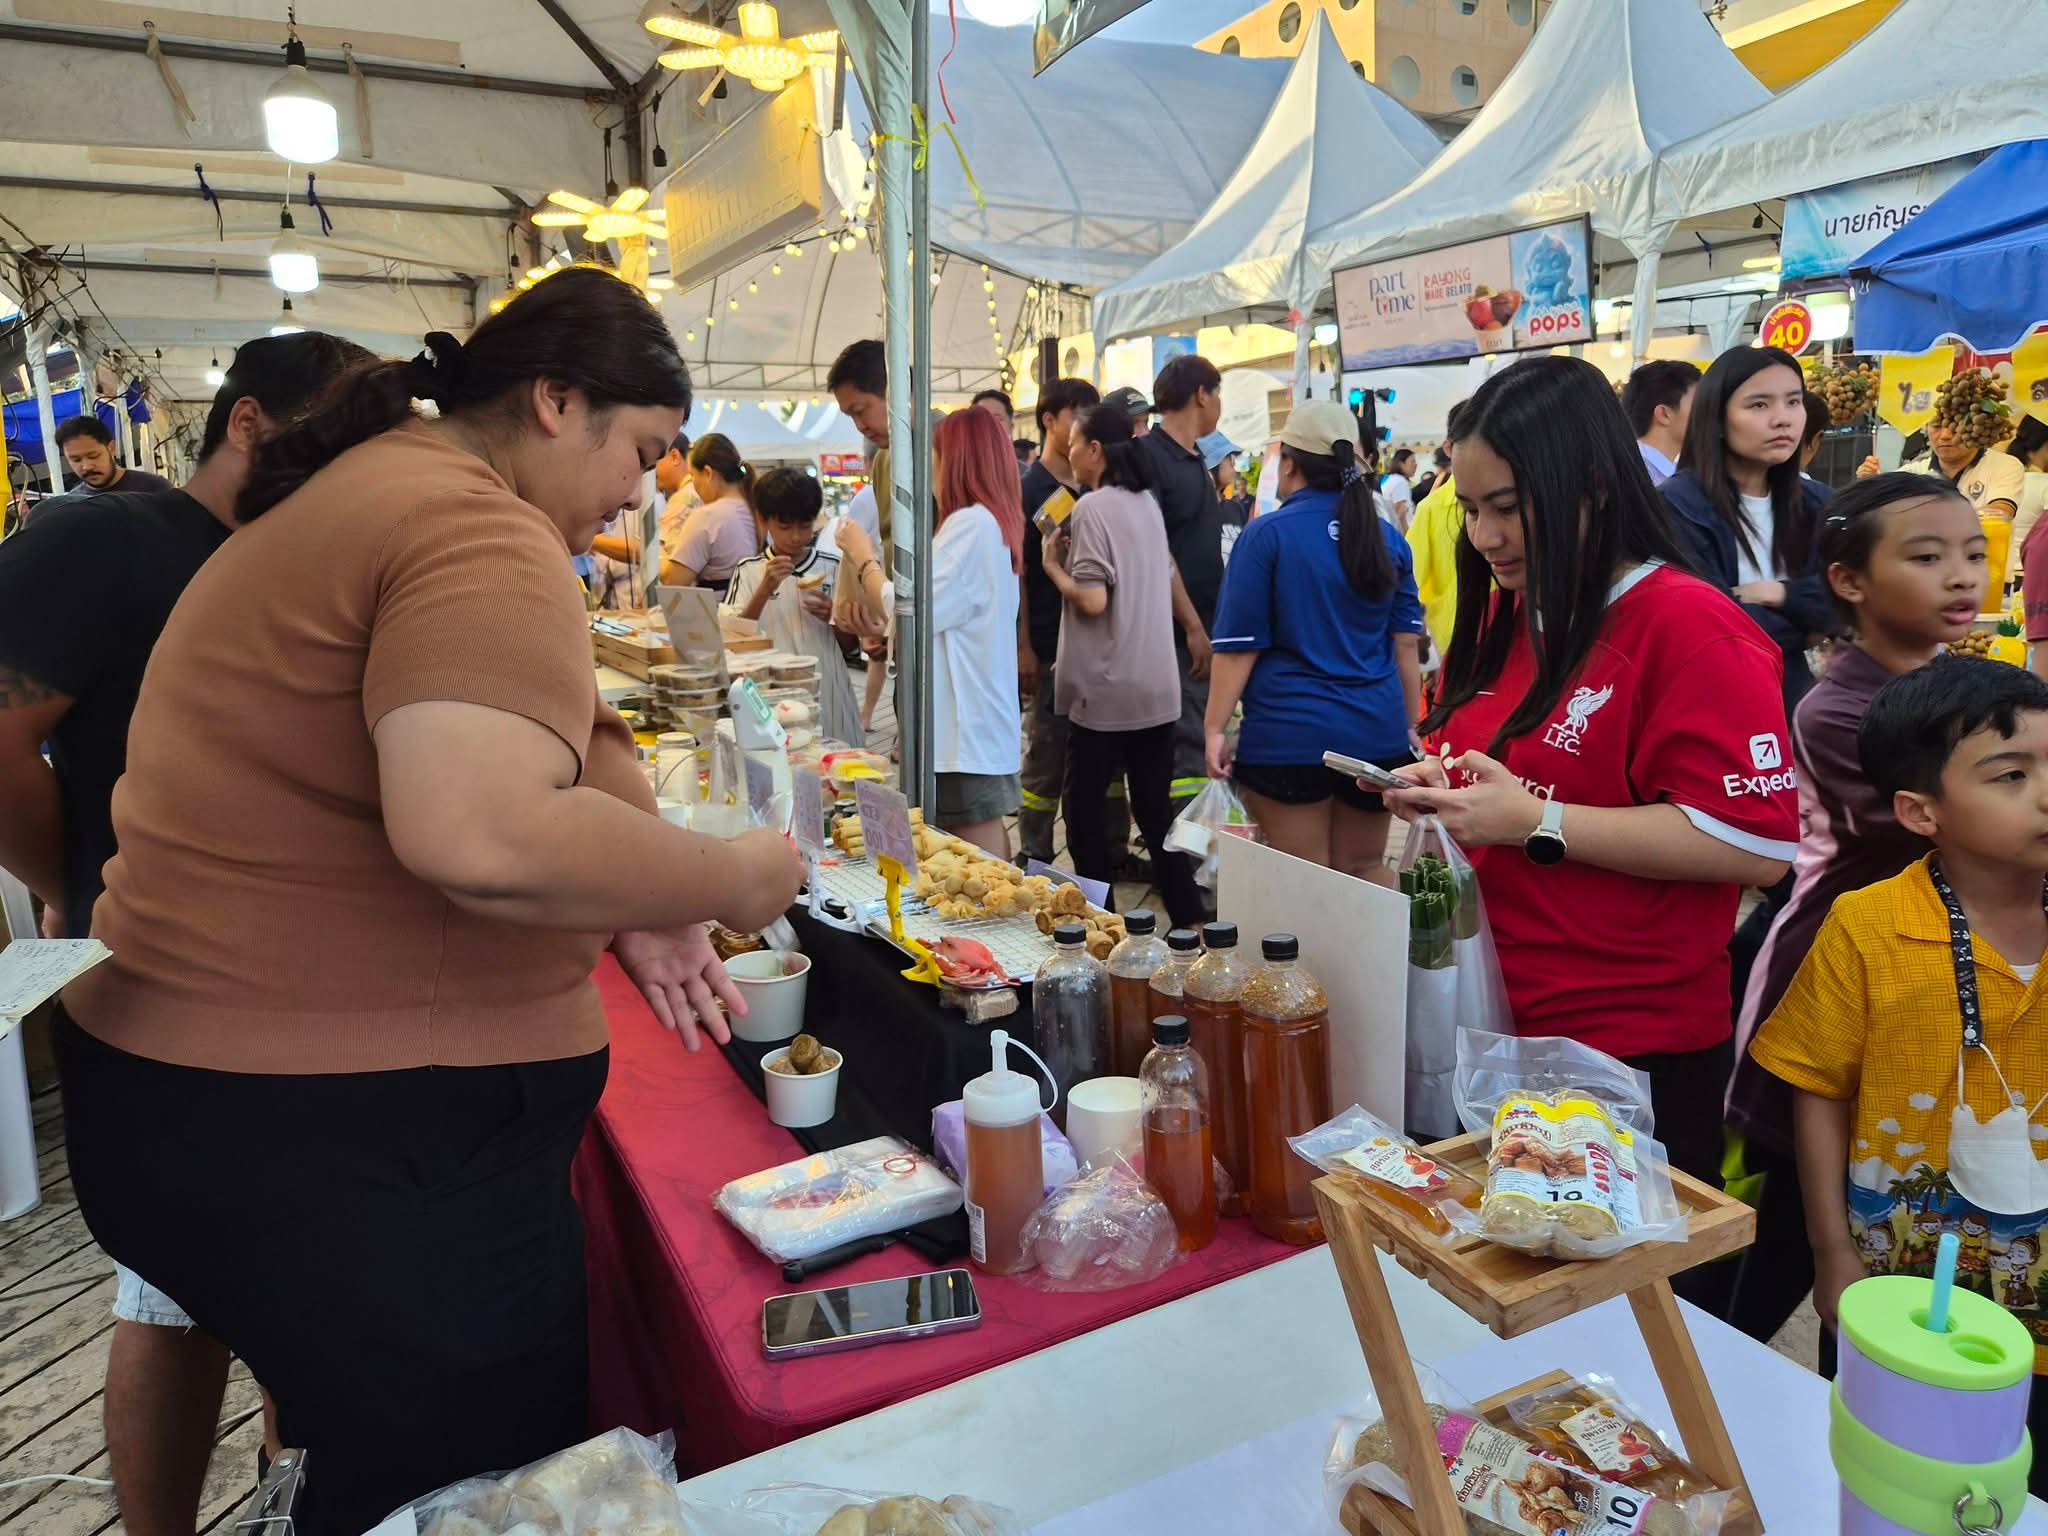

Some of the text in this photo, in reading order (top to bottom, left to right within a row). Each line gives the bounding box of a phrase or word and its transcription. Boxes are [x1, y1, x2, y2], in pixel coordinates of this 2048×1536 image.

[1369, 271, 1405, 301] part
[1768, 321, 1804, 348] 40
[1546, 1190, 1583, 1202] 10
[1606, 1495, 1639, 1530] 10
